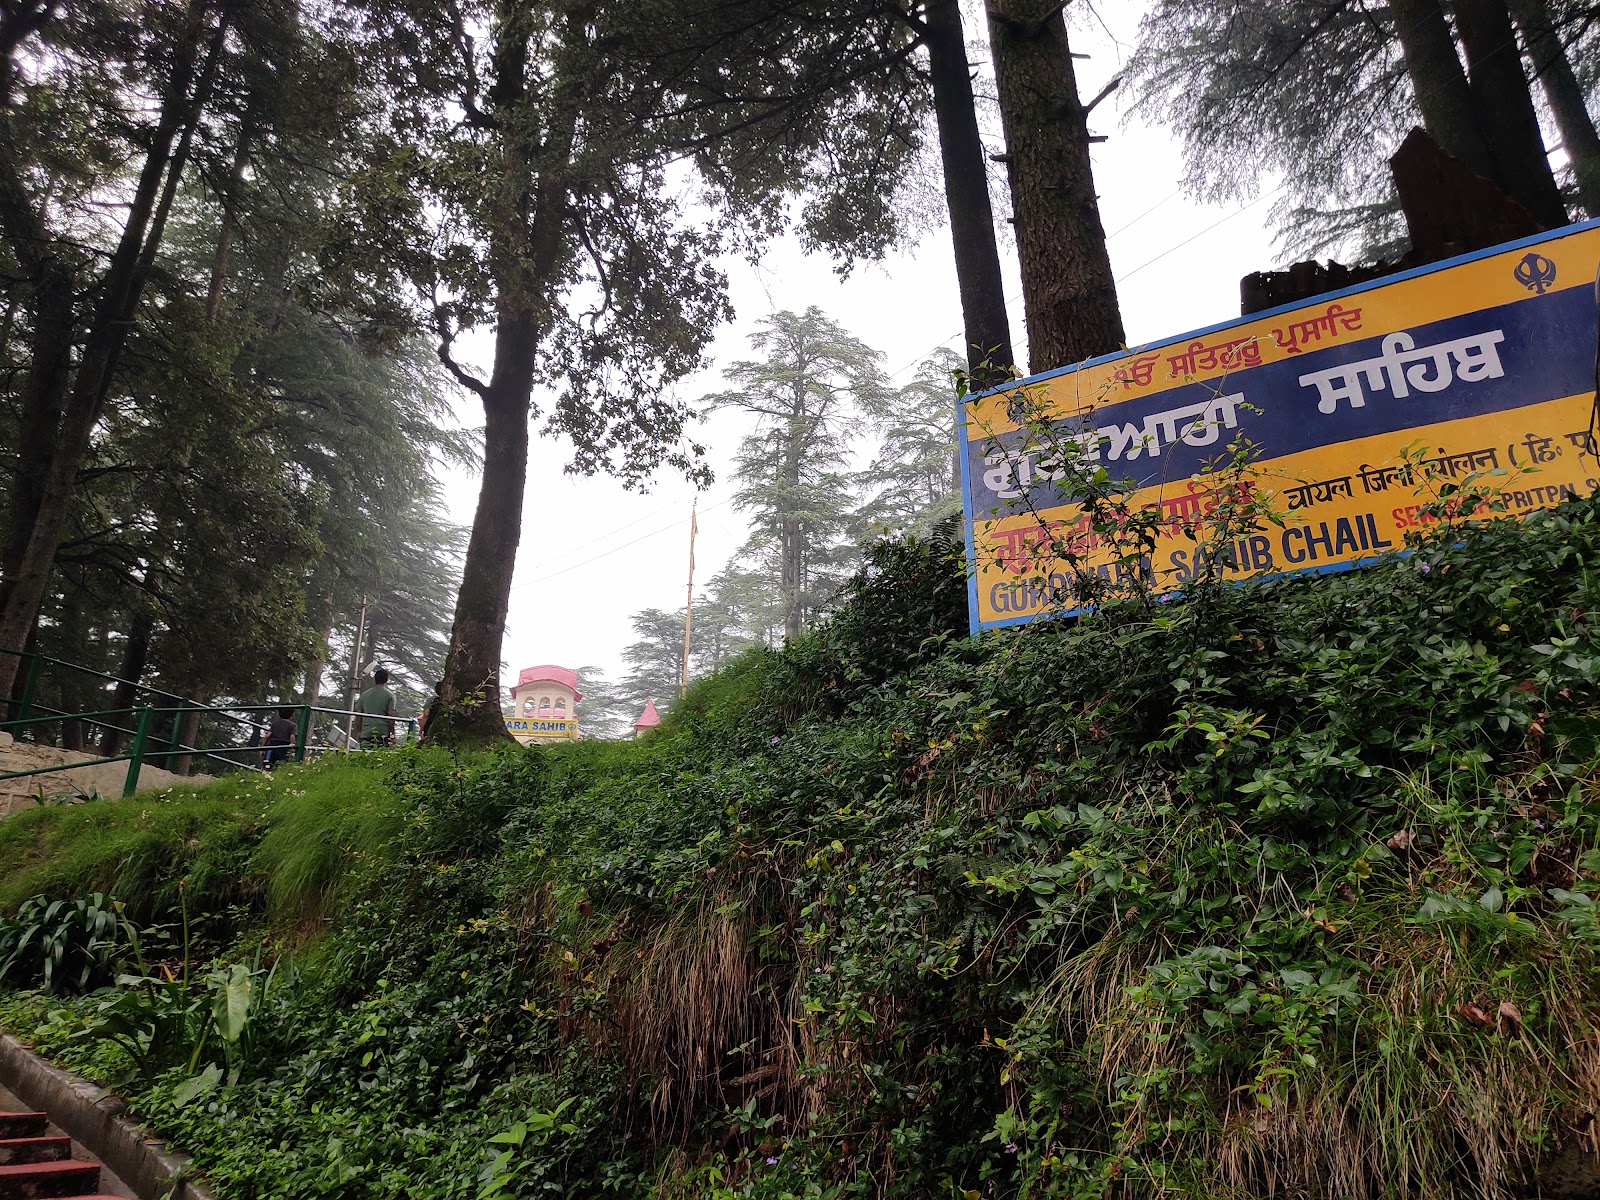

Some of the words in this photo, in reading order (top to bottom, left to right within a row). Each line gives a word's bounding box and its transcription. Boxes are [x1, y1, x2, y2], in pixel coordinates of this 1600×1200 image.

[1272, 304, 1362, 353] ਪ੍ਰਸਾਦਿ
[1299, 332, 1504, 414] ਸਾਹਿਬ
[1283, 475, 1357, 510] चायल
[1355, 464, 1415, 494] जिला
[1500, 482, 1584, 509] PRITPAL
[1281, 514, 1392, 563] CHAIL
[532, 722, 566, 731] SAHIB
